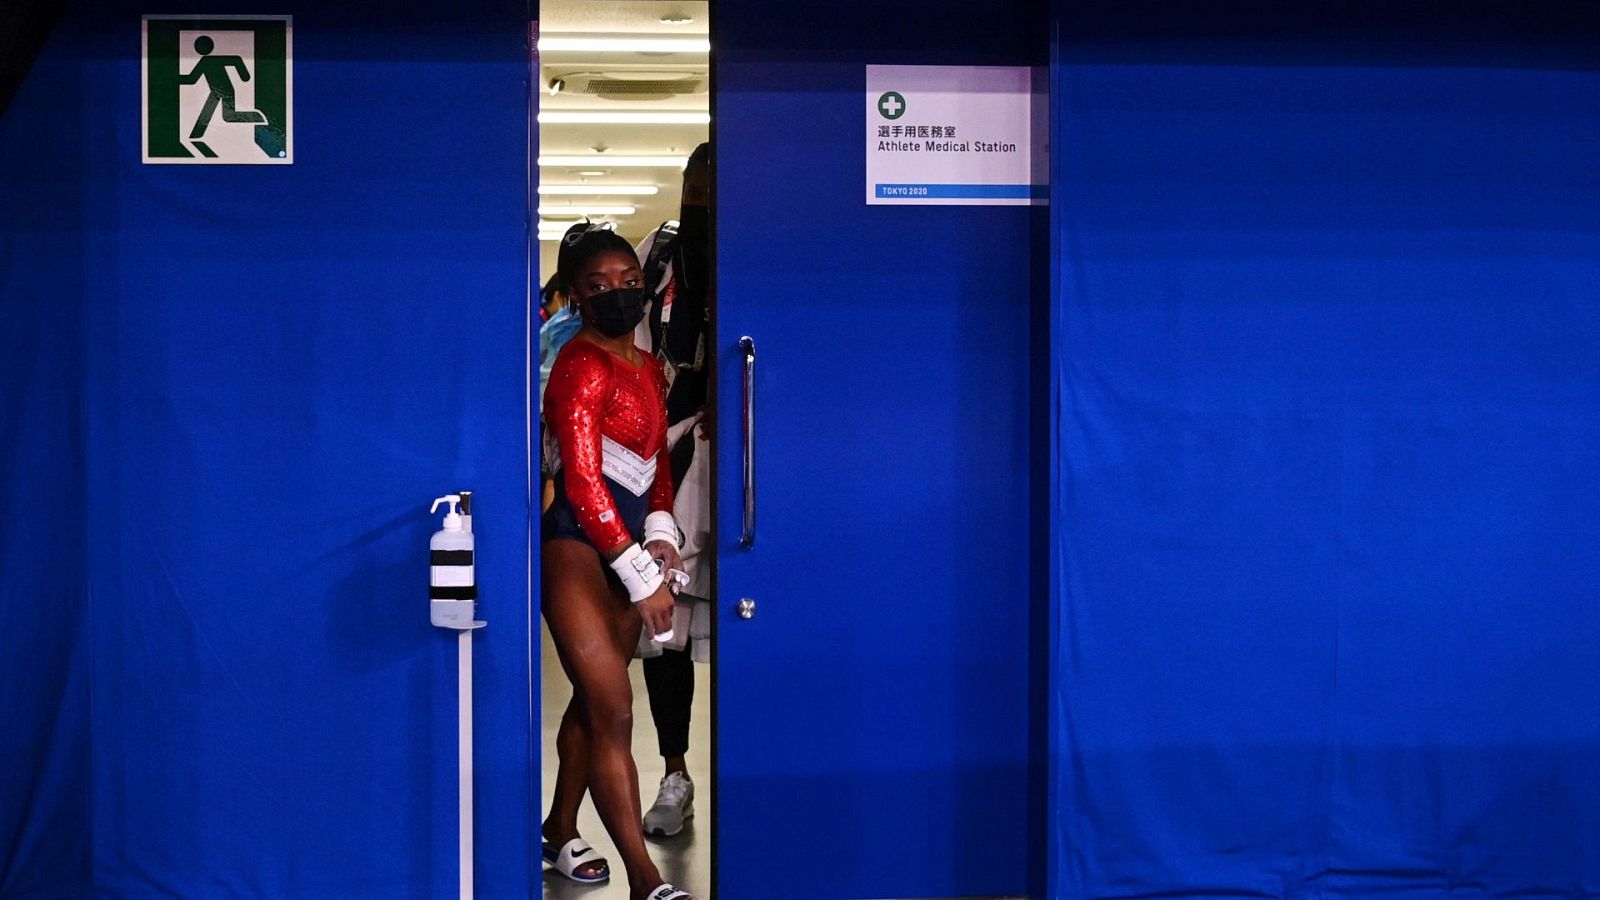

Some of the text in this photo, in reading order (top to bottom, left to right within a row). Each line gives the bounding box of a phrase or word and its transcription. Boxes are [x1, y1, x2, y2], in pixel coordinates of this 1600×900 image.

[878, 125, 956, 138] 選手用医務室
[878, 141, 1016, 152] Athlete Medical Station
[882, 187, 928, 195] TOKYO 2020
